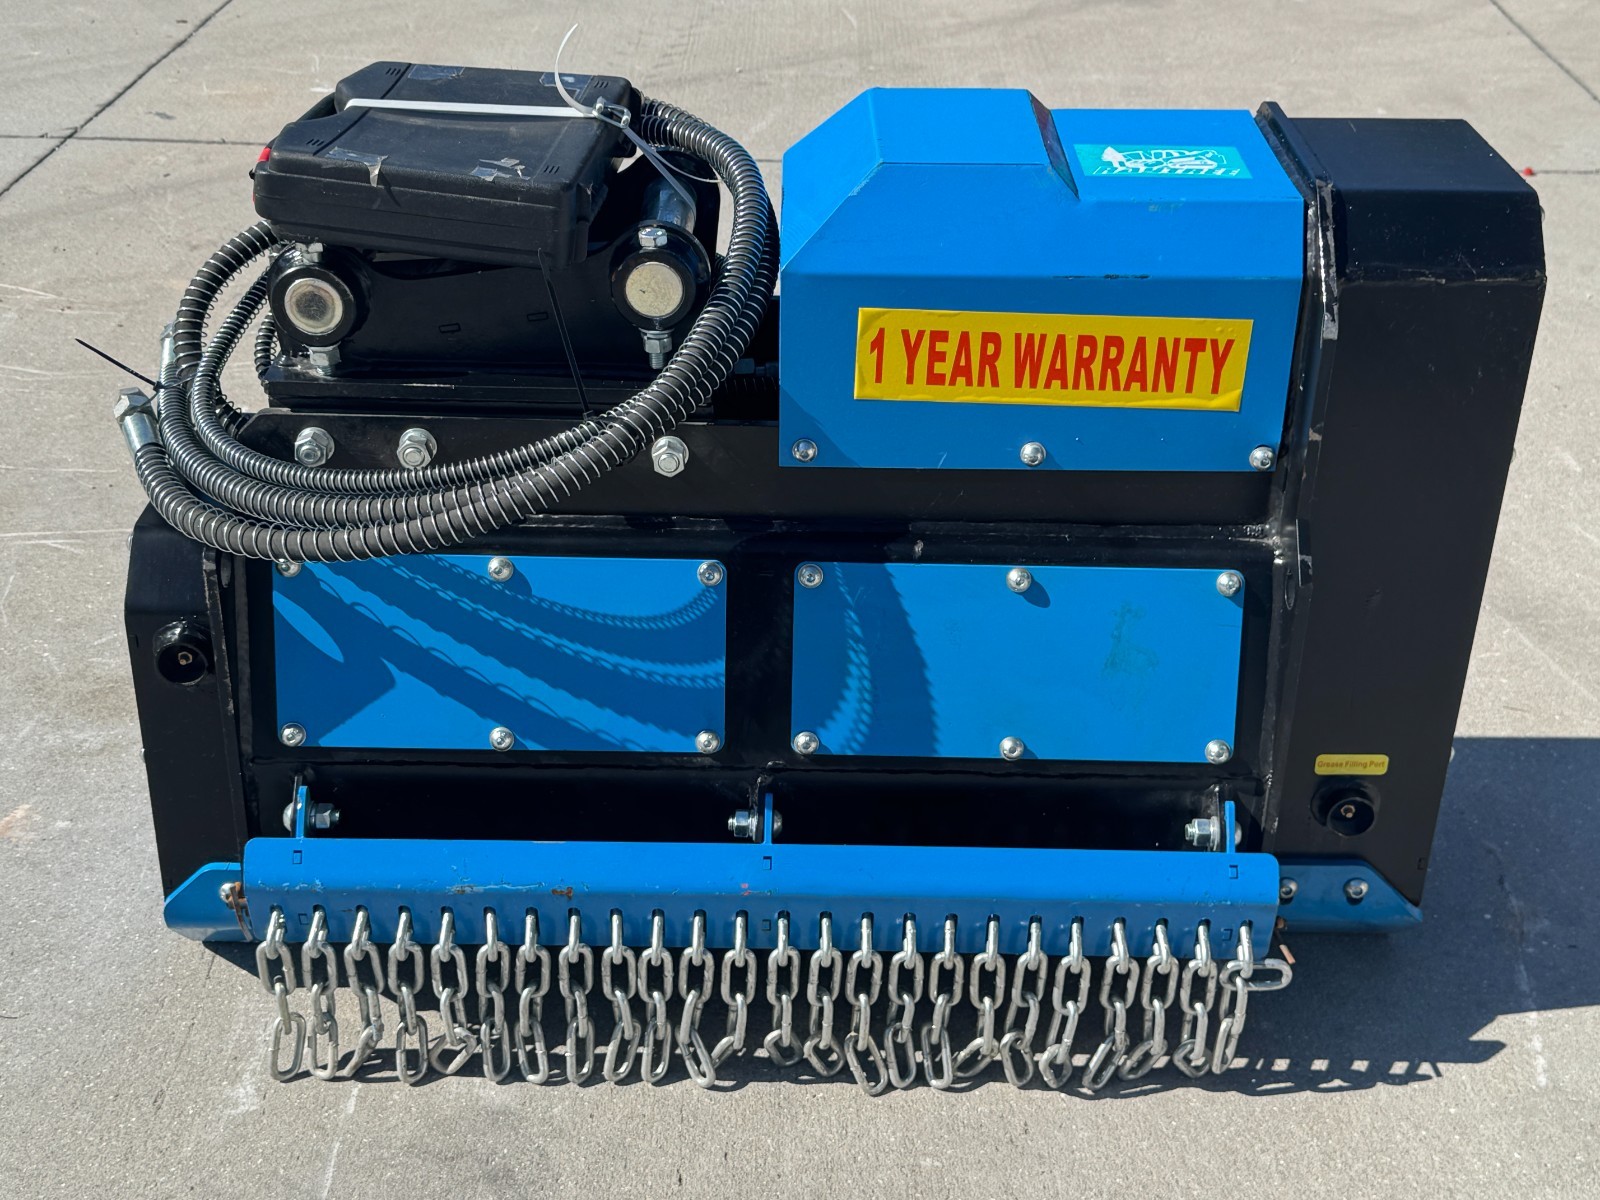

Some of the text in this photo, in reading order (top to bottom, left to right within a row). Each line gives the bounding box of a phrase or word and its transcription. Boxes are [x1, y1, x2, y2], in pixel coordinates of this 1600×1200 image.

[869, 327, 1236, 396] 1 YEAR WARRANTY
[1317, 760, 1385, 769] Grease Filling Port
